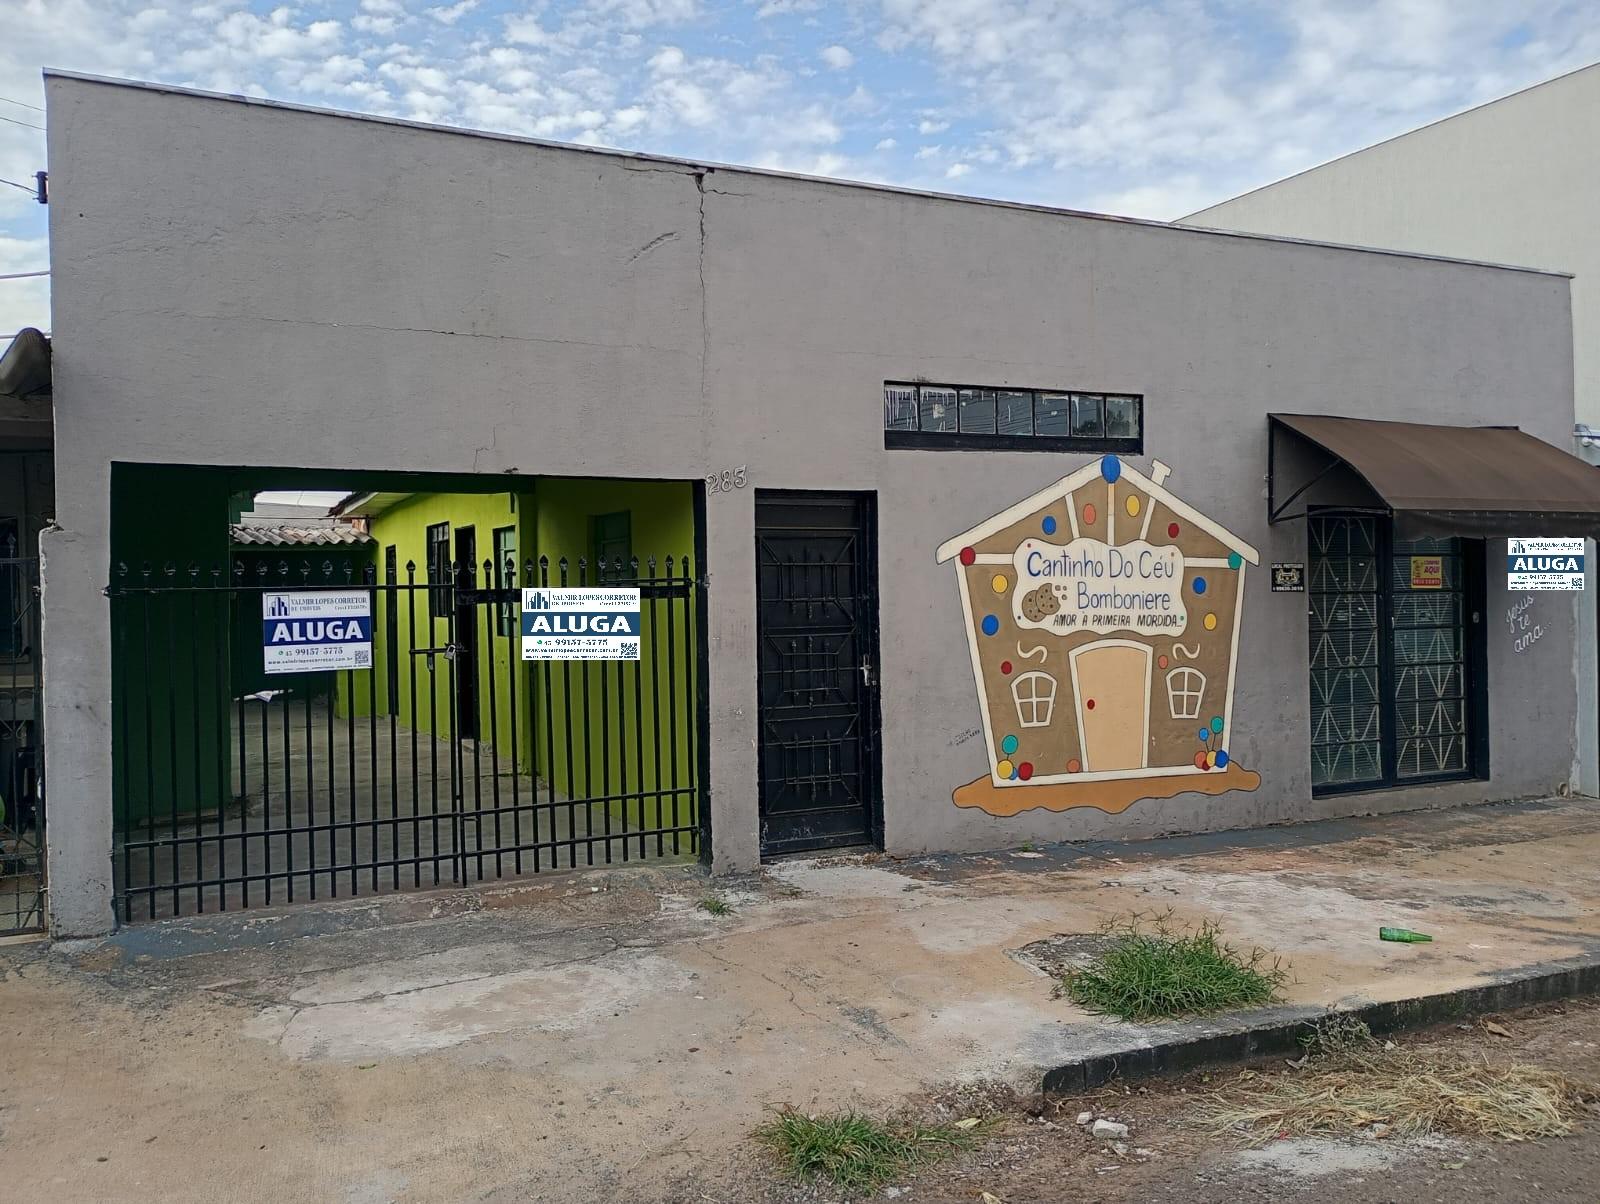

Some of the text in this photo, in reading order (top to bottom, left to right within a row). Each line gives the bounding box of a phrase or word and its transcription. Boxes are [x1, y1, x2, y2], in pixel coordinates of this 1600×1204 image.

[1026, 549, 1175, 579] Cantinho Do Céu
[1077, 581, 1171, 611] Bomboniere
[272, 620, 363, 642] ALUGA
[1053, 614, 1077, 627] AMOR
[1092, 614, 1131, 627] PRIMEIRA
[1517, 614, 1531, 630] te
